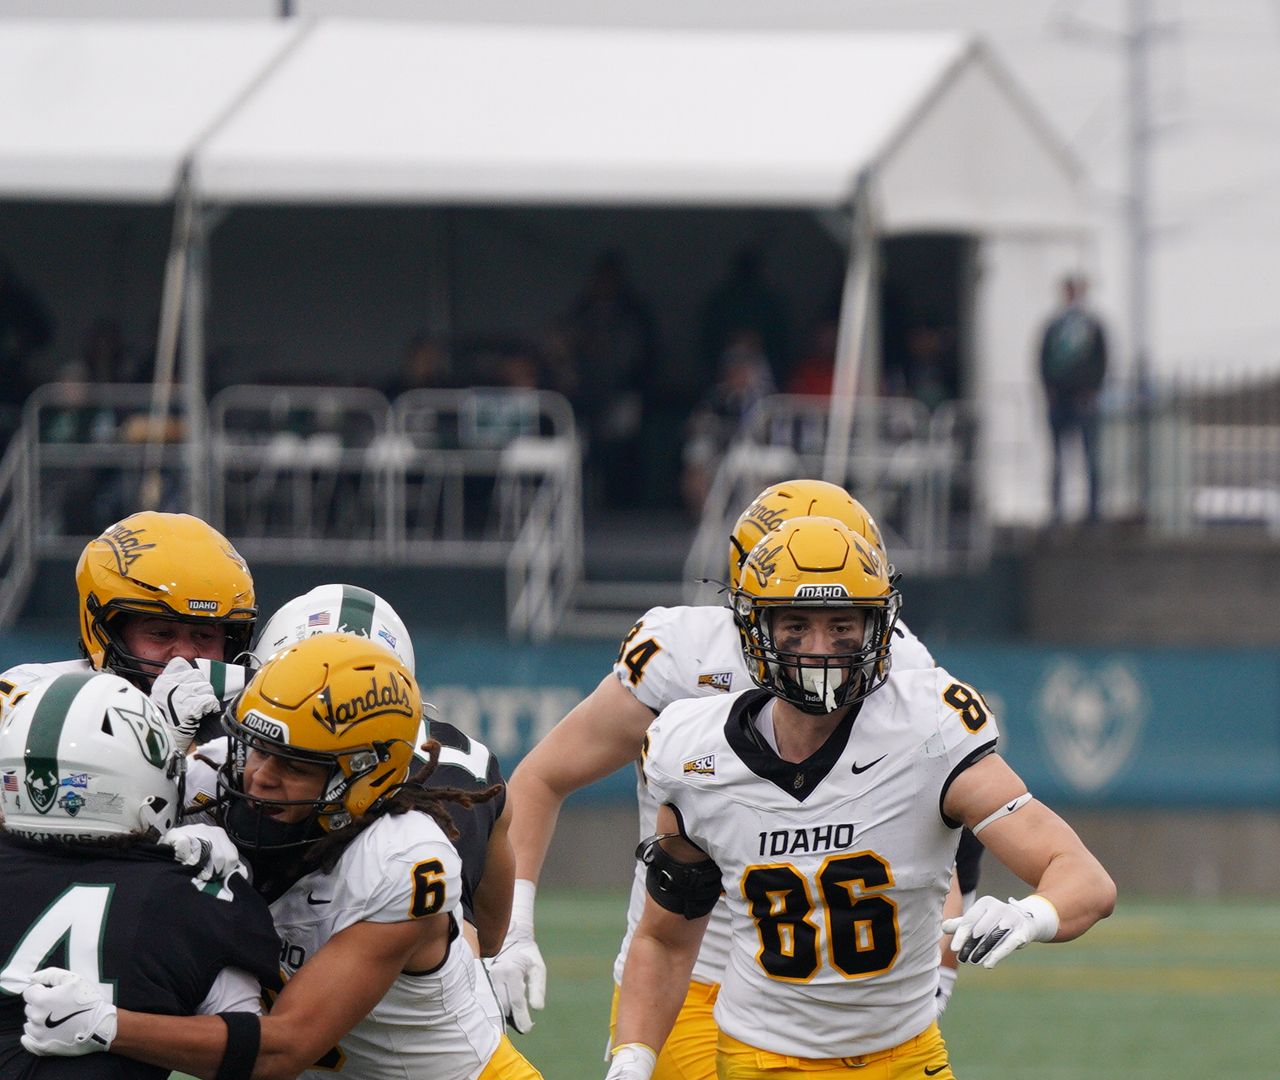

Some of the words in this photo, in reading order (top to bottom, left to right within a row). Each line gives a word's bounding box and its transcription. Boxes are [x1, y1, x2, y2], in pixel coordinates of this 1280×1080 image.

[189, 601, 217, 610] IDAHO
[802, 587, 842, 598] IDAHO
[312, 672, 413, 738] Vandals
[245, 712, 282, 739] IDAHO
[696, 756, 714, 770] SKY
[759, 823, 855, 857] IDAHO
[407, 857, 447, 920] 6
[739, 850, 901, 983] 86
[0, 882, 119, 1005] 4
